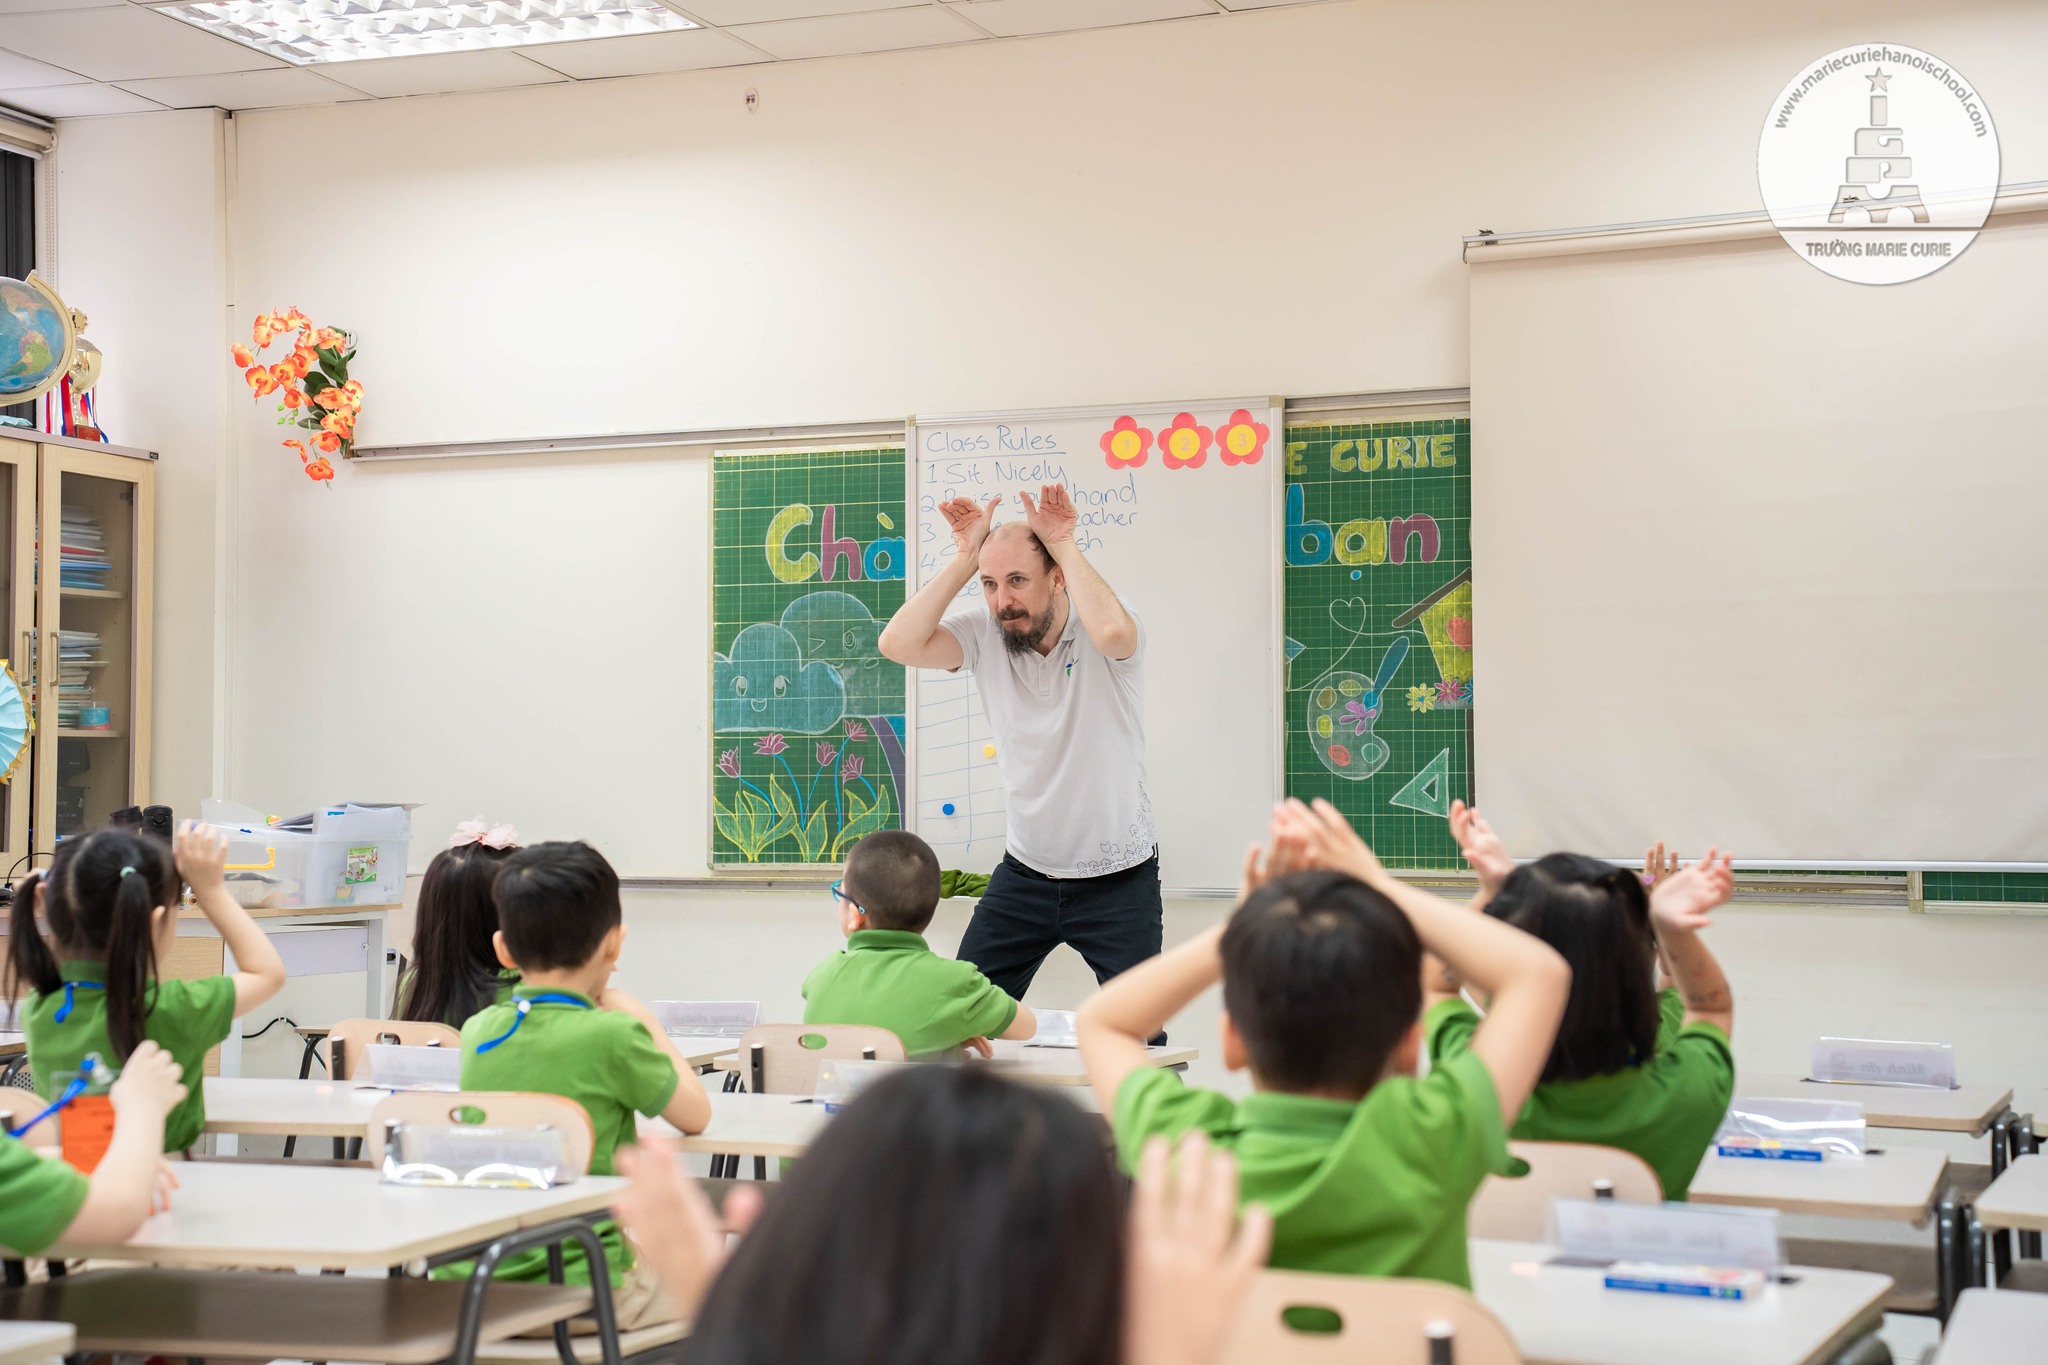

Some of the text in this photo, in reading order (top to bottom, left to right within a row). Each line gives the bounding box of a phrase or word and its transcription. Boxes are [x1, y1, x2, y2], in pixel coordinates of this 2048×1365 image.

[926, 425, 1057, 452] Class Rules
[1123, 433, 1248, 452] 1 2 3
[1331, 435, 1457, 473] CURIE
[995, 459, 1068, 490] Nicely
[1073, 472, 1137, 506] hand
[1074, 507, 1138, 527] eacher
[765, 503, 906, 584] Chà
